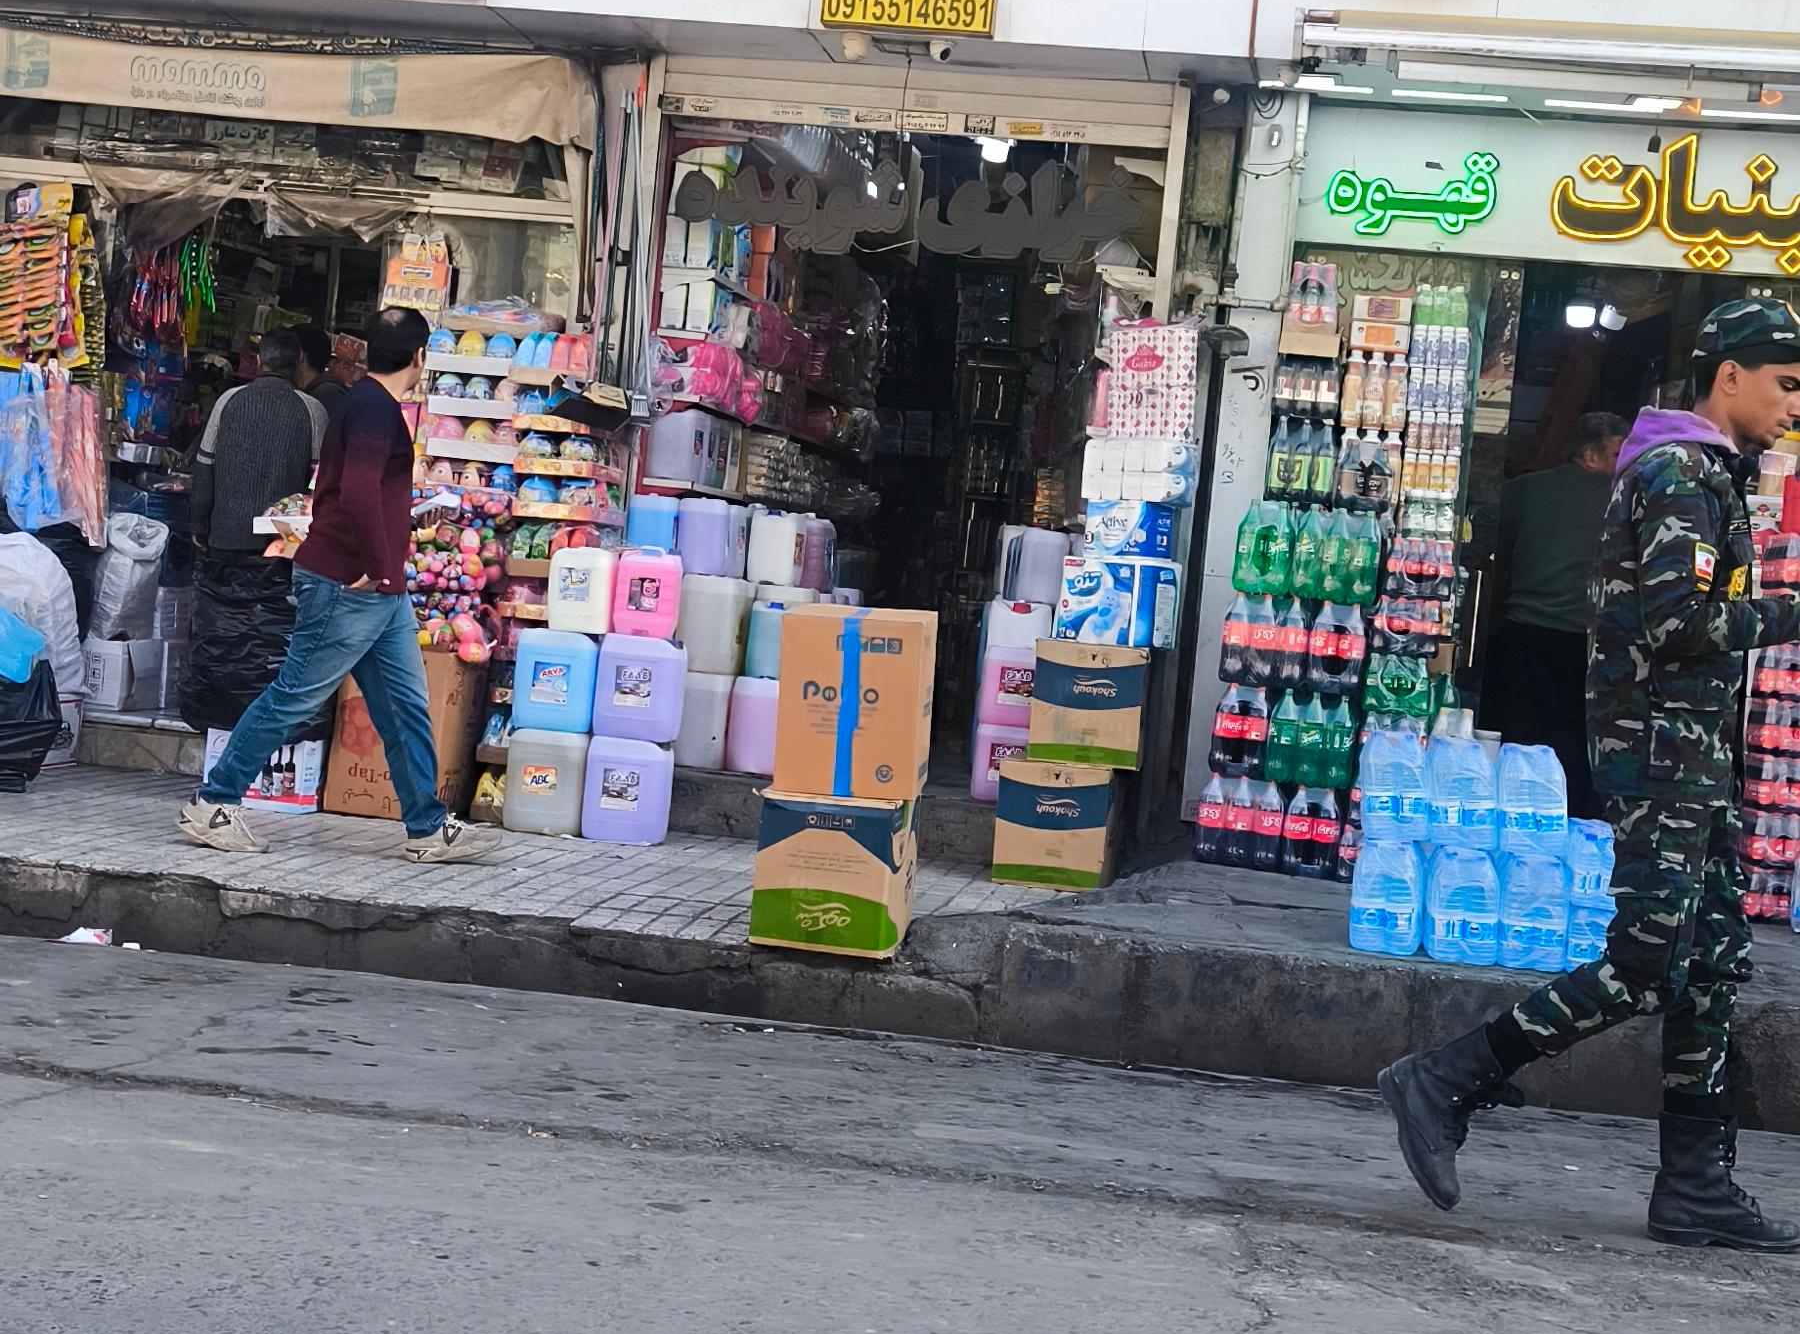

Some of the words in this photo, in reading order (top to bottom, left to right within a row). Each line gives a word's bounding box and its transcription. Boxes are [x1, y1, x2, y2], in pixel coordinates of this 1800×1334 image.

[1328, 151, 1500, 236] قهوه
[1072, 684, 1118, 698] Shakouh
[530, 773, 549, 786] ABC
